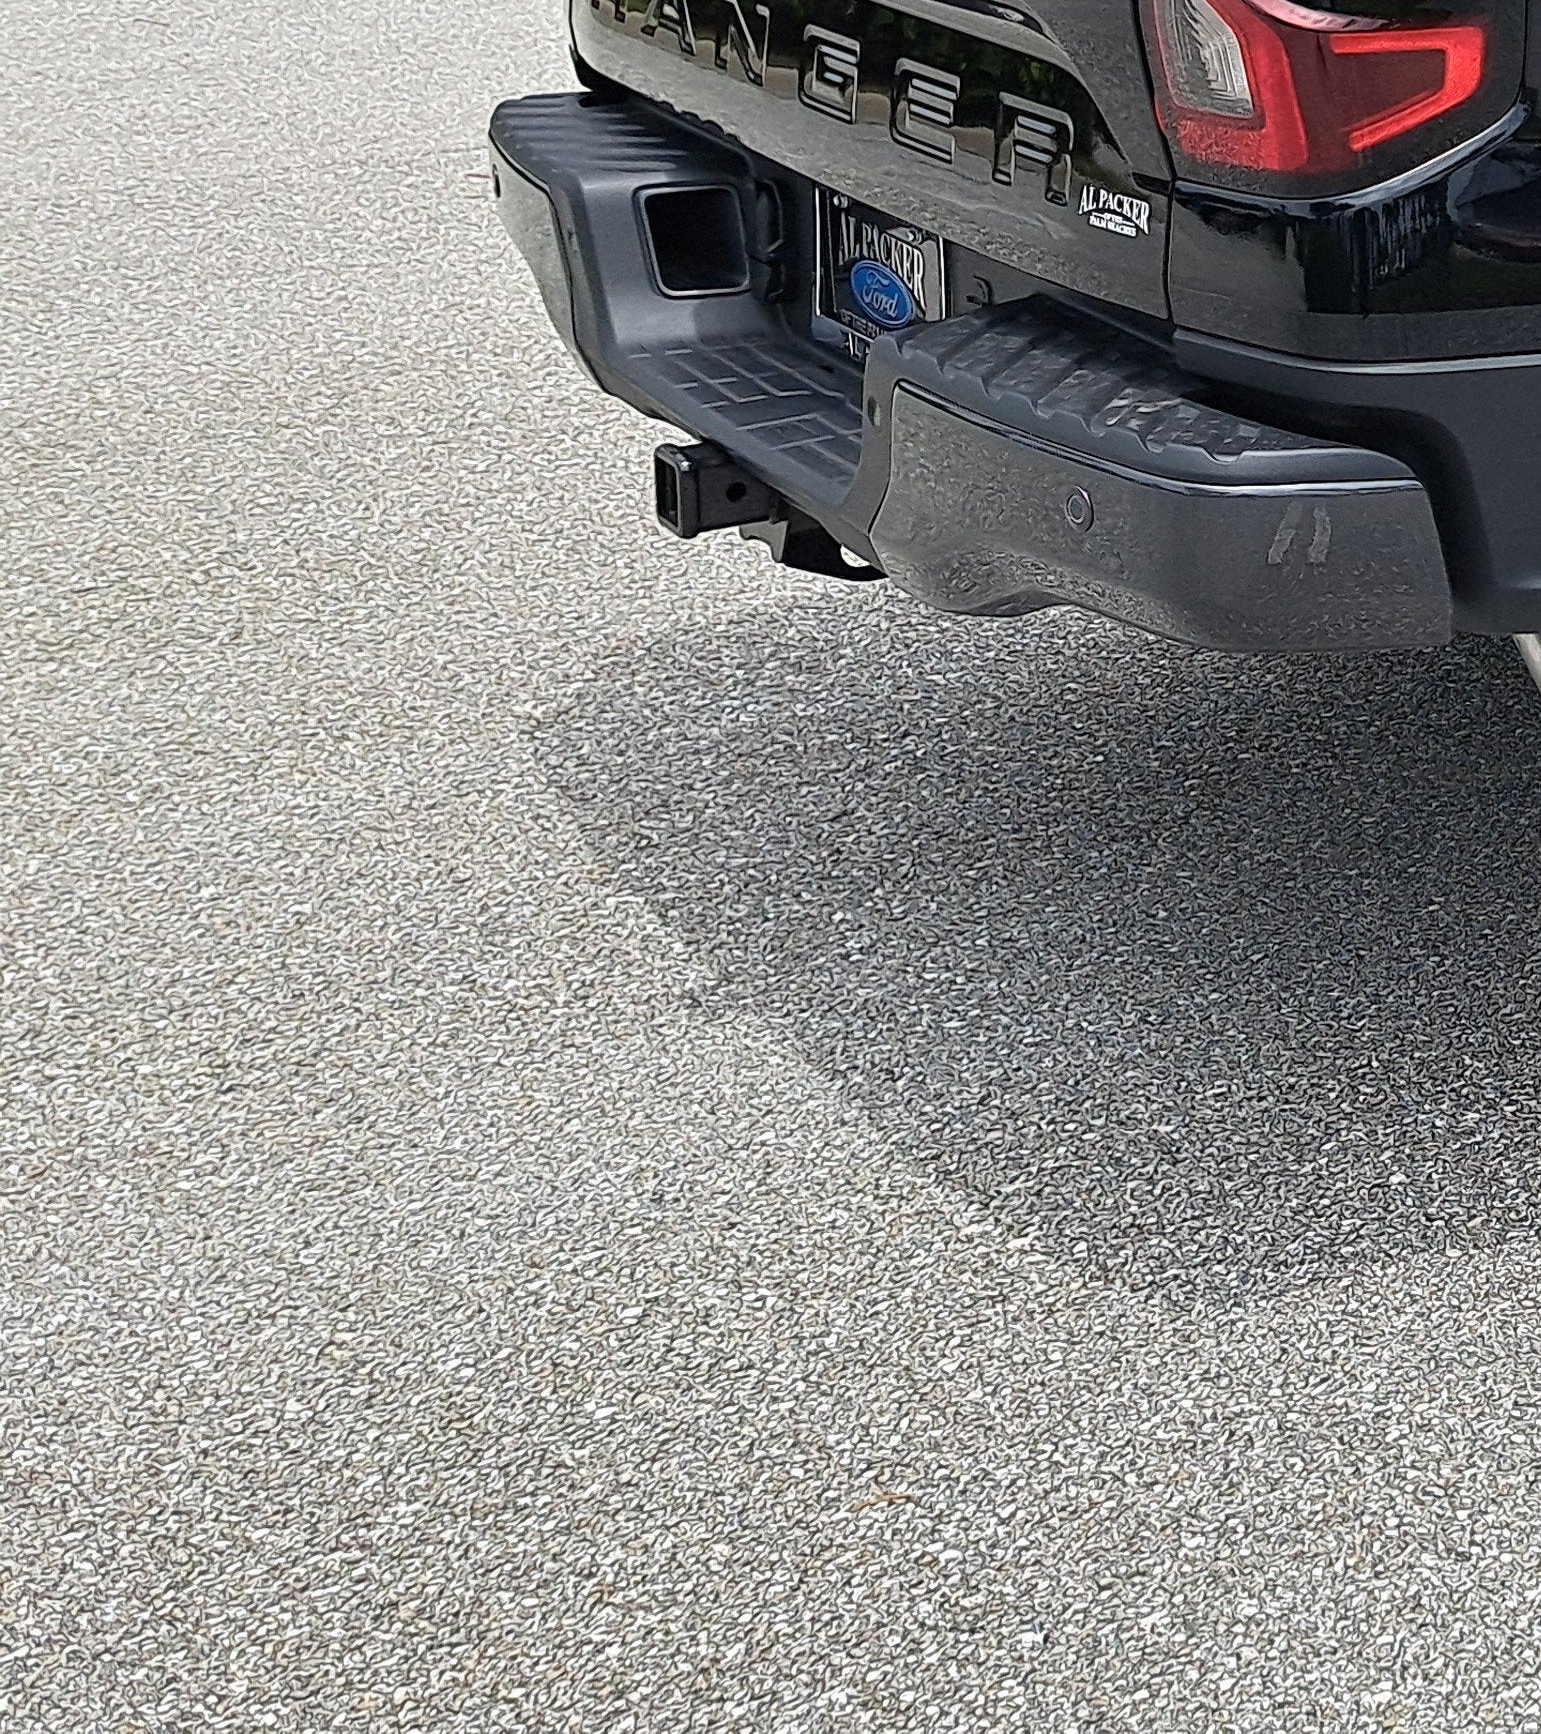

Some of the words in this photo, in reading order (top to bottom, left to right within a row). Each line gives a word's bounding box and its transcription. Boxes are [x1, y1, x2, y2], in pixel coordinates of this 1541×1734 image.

[1079, 184, 1097, 215] AL
[1098, 187, 1150, 235] PACKER
[838, 211, 860, 266] AL
[861, 221, 927, 314] PACKER
[861, 270, 901, 318] Ford
